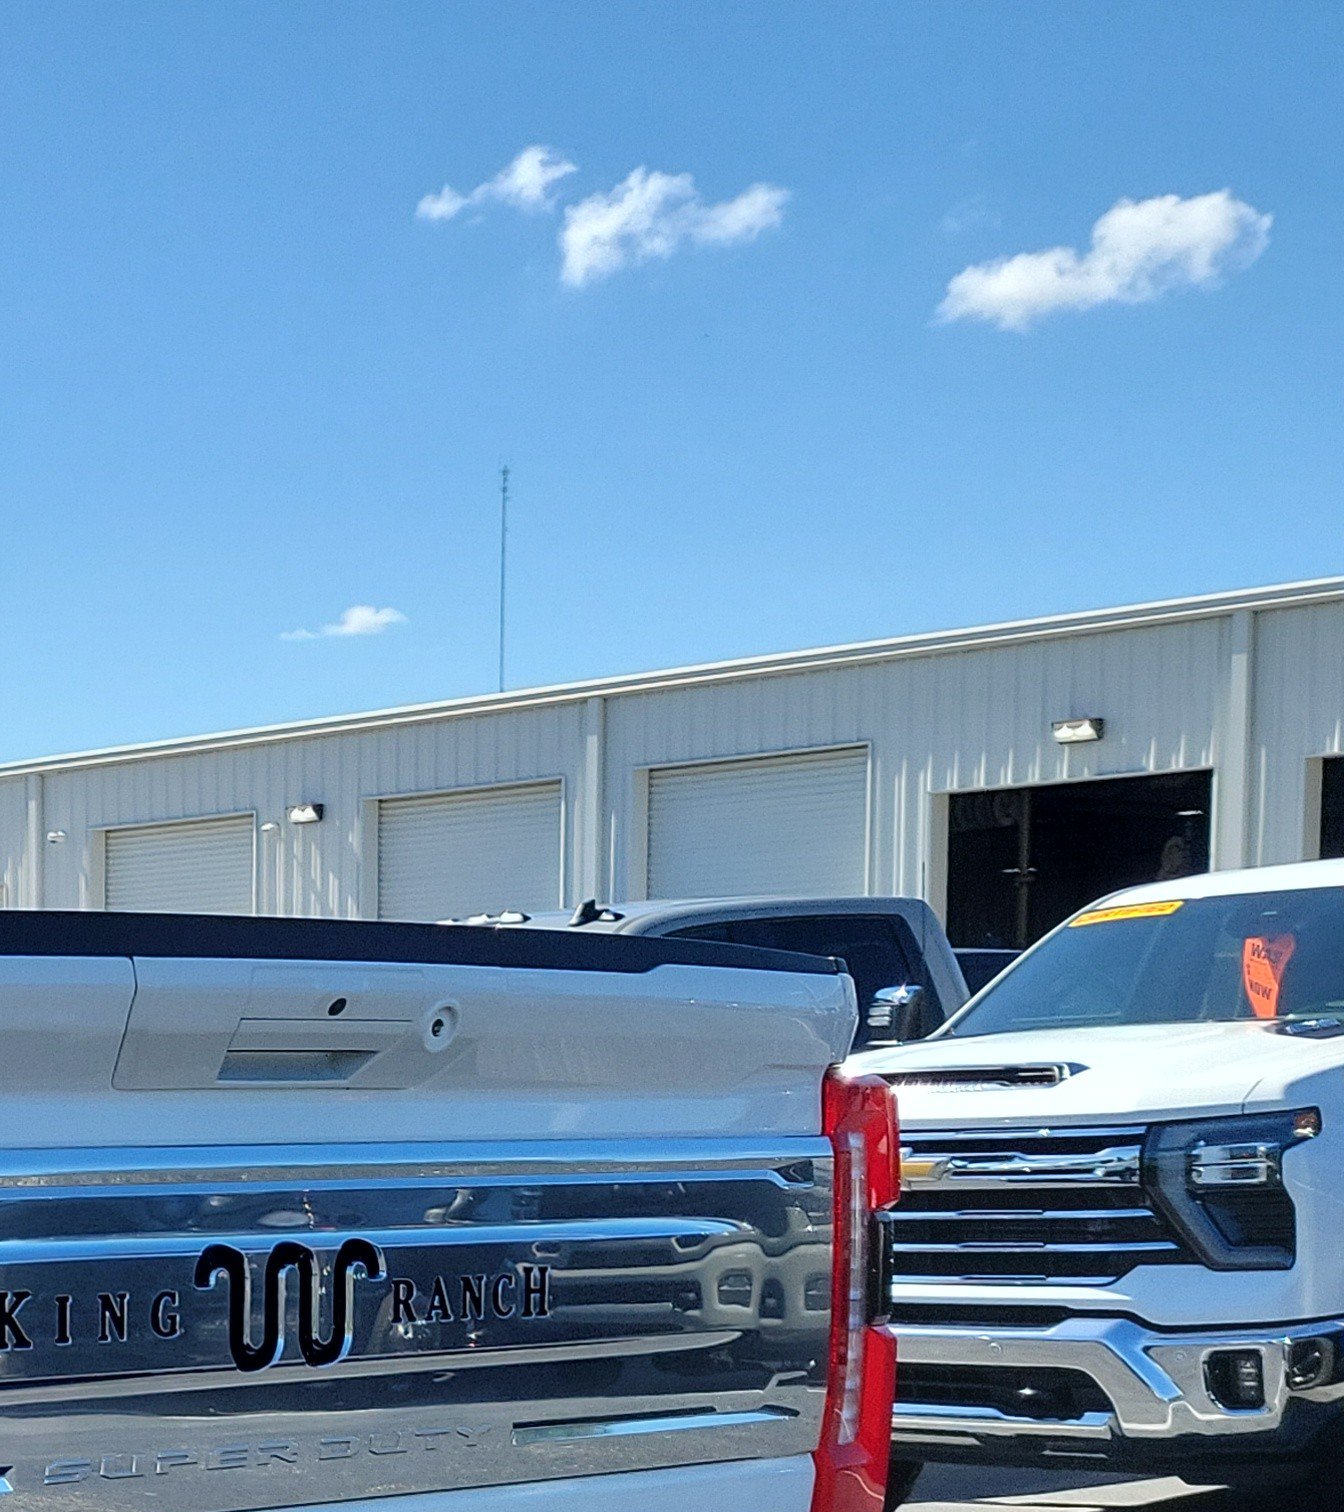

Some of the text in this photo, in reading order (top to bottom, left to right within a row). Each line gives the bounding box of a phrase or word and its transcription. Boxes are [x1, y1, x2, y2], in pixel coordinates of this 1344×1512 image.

[389, 1264, 554, 1325] RANCH
[42, 1423, 492, 1486] SUPER DUTY
